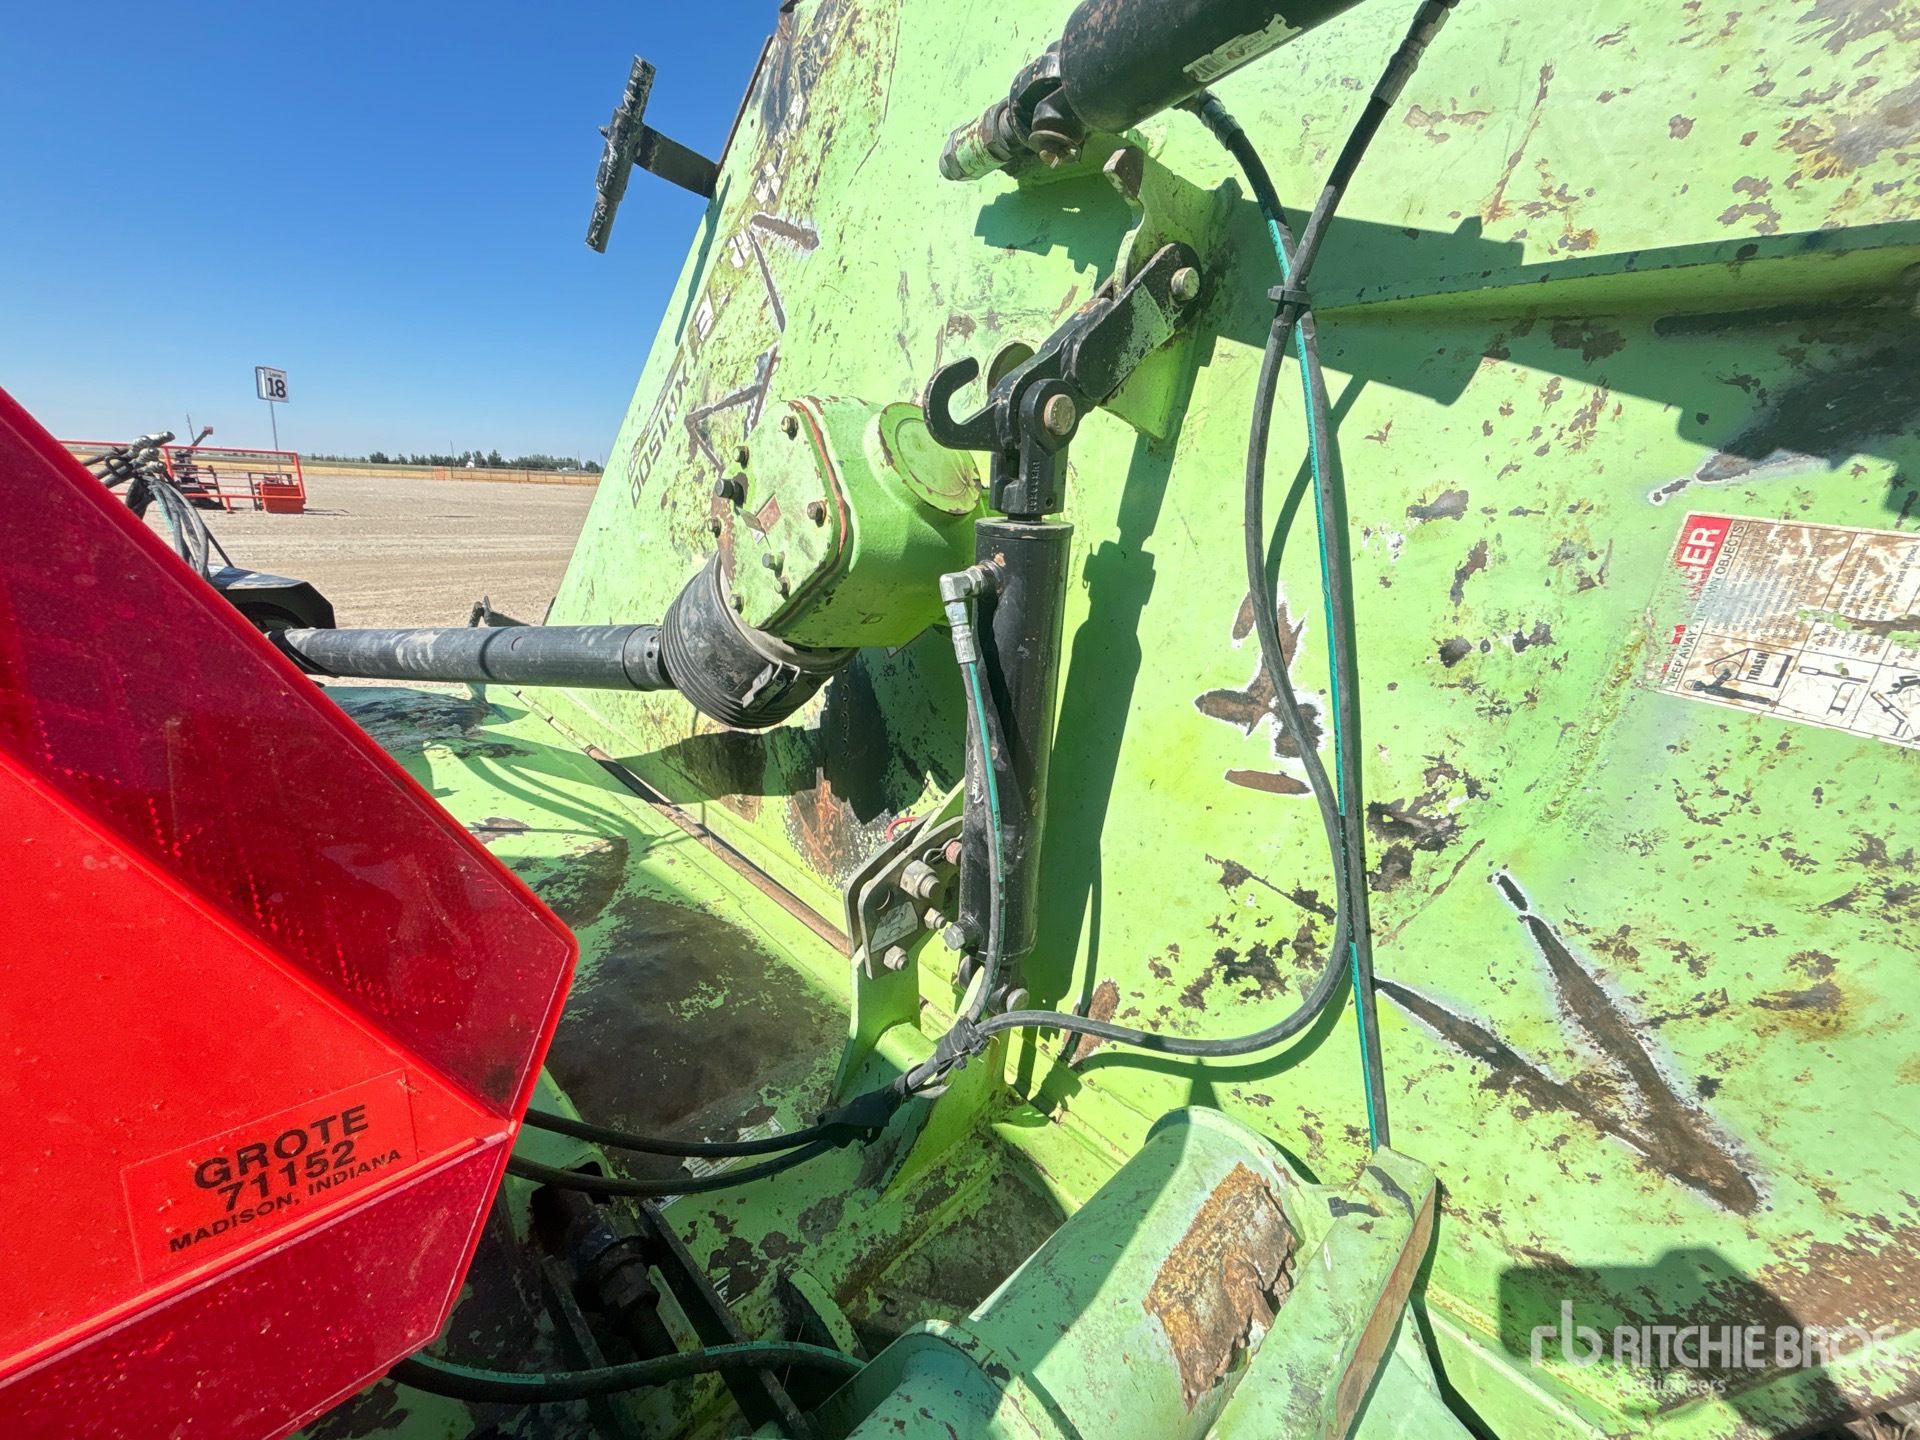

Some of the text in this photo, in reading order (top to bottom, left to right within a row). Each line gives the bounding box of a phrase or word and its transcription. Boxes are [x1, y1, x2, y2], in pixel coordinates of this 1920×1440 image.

[267, 377, 286, 398] 18
[1713, 525, 1744, 574] OBJECTS
[1745, 651, 1770, 682] TRASH
[194, 1104, 369, 1190] GROTE
[217, 1140, 356, 1213] 71152
[169, 1148, 402, 1253] MADISON, INDIANA
